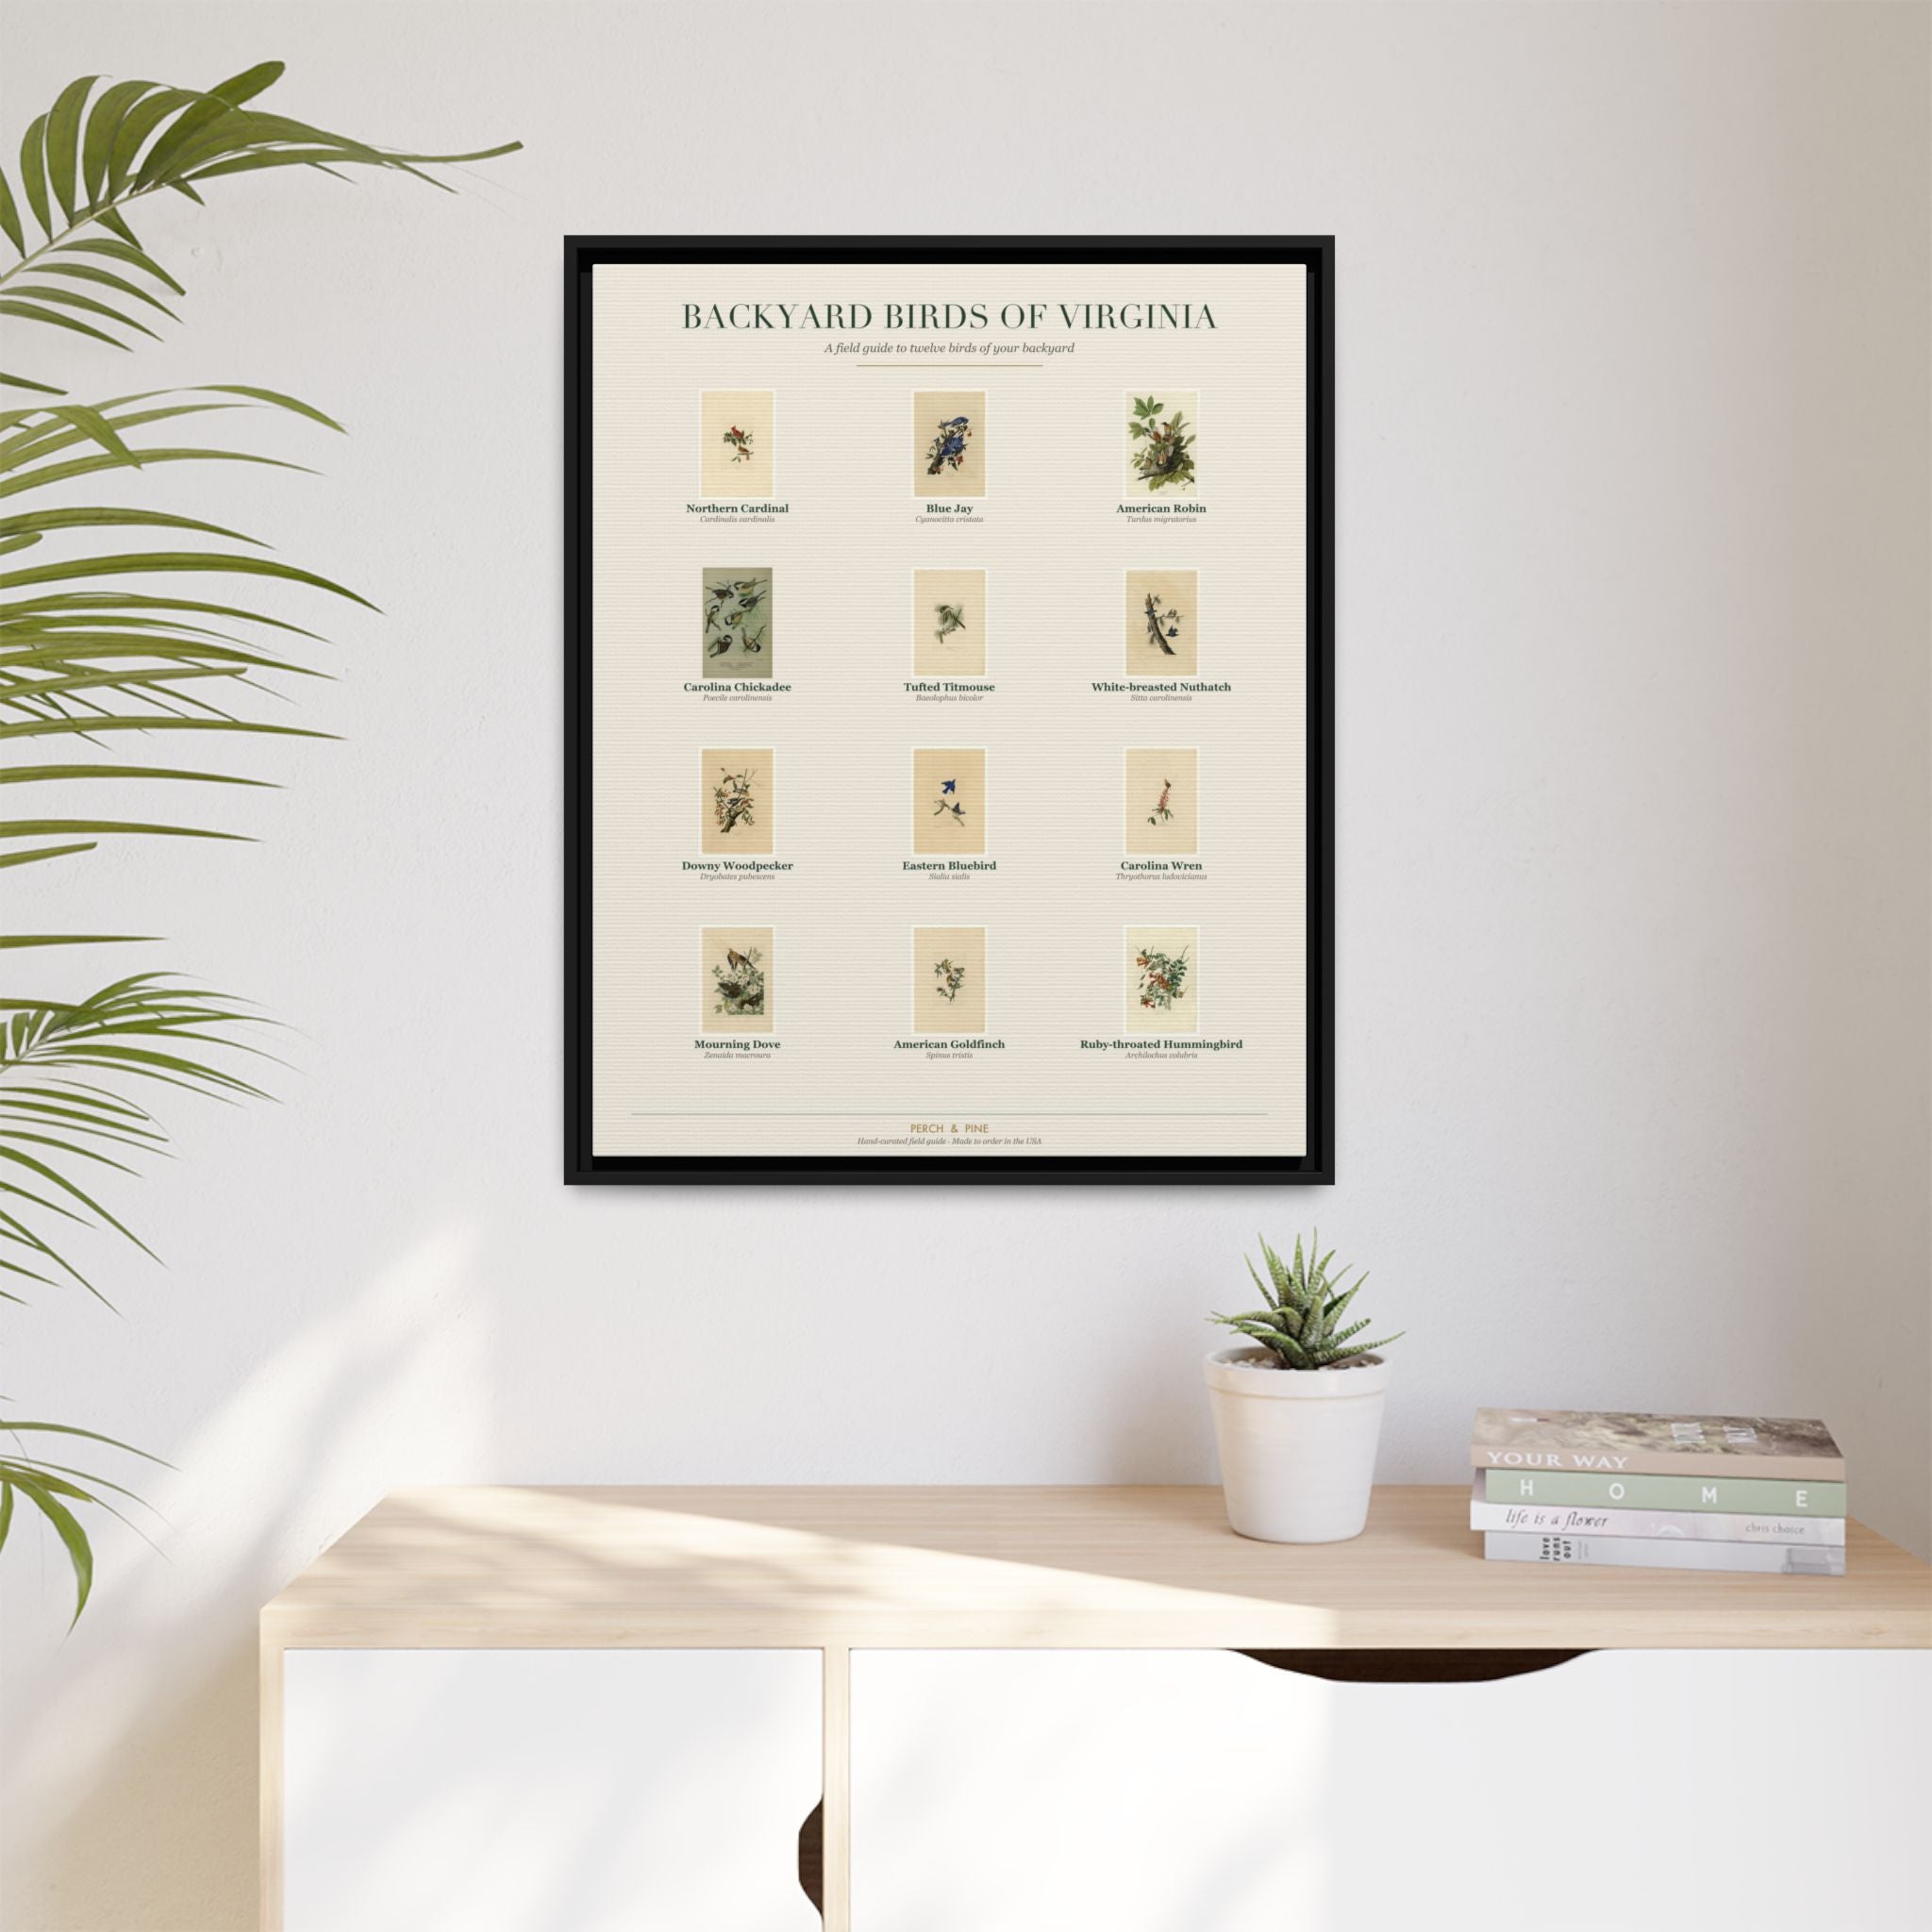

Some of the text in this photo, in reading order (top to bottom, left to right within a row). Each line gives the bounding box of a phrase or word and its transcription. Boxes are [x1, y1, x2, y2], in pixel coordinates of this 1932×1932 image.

[681, 303, 1219, 329] BACKYARD BIRDS OF VIRGINIA
[824, 342, 1075, 356] A field guide to twelve birds of your backyard
[686, 503, 790, 513] Northern Cardinal
[925, 503, 974, 515] Blue Jay
[1116, 503, 1208, 513] American Robin
[699, 514, 775, 524] Cardinalis cardinalis
[915, 515, 984, 525] Cyanocitta cristata
[1125, 514, 1197, 525] Turdus migratorius
[683, 681, 792, 692] Carolina Chickadee
[903, 681, 996, 692] Tufted Titmouse
[1091, 681, 1232, 692] White-breasted Nuthatch
[702, 693, 773, 702] Poecile carolinensis
[915, 693, 985, 703] Baeolophus bicolor
[1130, 693, 1193, 703] Sitta carolinensis
[681, 860, 794, 873] Downy Woodpecker
[902, 860, 997, 871] Eastern Bluebird
[1120, 860, 1203, 871] Carolina Wren
[699, 873, 775, 882] Dryobates pubescens
[928, 872, 971, 880] Sialia sialis
[1115, 872, 1208, 882] Thryothorus ludovicianus
[693, 1039, 781, 1051] Mourning Dove
[893, 1039, 1006, 1050] American Goldfinch
[1079, 1039, 1243, 1051] Ruby-throated Hummingbird
[703, 1051, 734, 1059] Zenaida
[925, 1051, 974, 1061] Spinus tristis
[1124, 1051, 1198, 1059] Archilochus colubris
[910, 1124, 990, 1134] PERCH & PINE
[857, 1137, 908, 1145] Hand-curated
[908, 1137, 925, 1146] field
[925, 1137, 947, 1146] guide
[951, 1137, 973, 1145] Made
[982, 1137, 1003, 1145] order
[1004, 1137, 1011, 1145] in
[1012, 1137, 1024, 1145] the
[1025, 1137, 1042, 1145] USA
[1487, 1451, 1629, 1469] YOUR WAY
[1520, 1478, 1808, 1507] HOME
[1506, 1508, 1608, 1531] life is a flower
[1745, 1522, 1805, 1536] chris choice
[1540, 1537, 1551, 1560] love
[1553, 1537, 1561, 1562] runs
[1562, 1541, 1572, 1559] out
